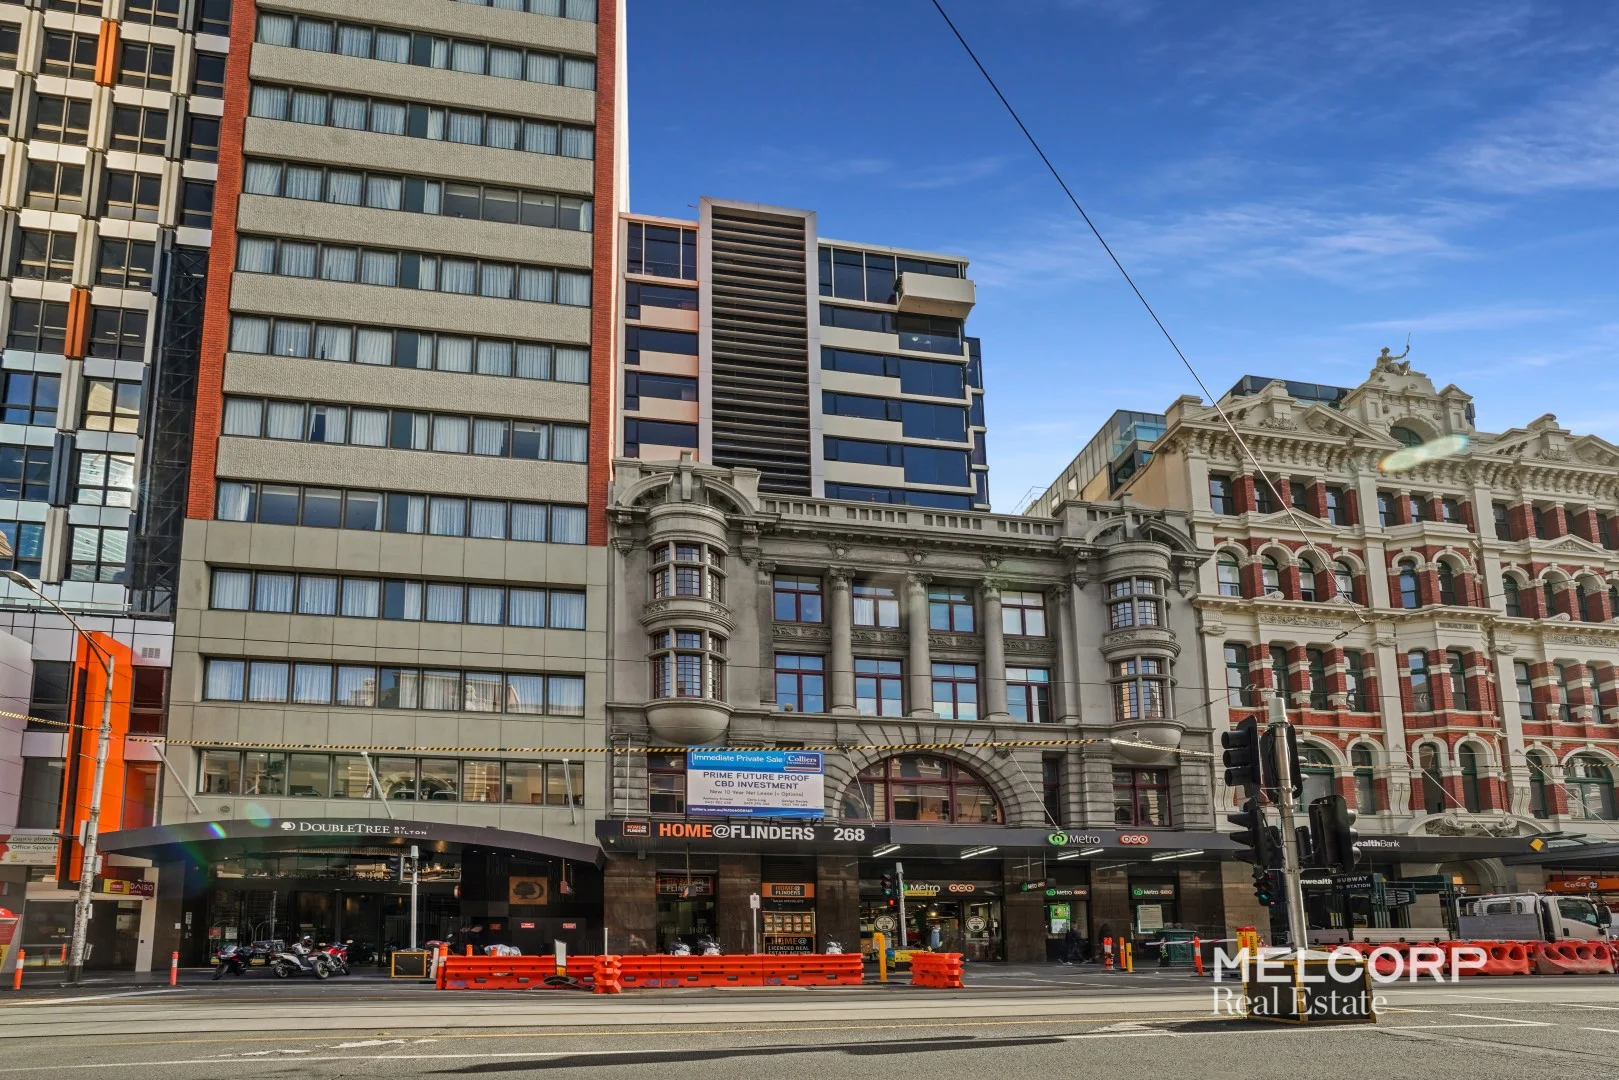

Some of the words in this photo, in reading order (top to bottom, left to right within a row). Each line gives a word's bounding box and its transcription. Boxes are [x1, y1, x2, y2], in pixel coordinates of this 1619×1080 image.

[736, 772, 774, 780] FUTURE
[738, 782, 798, 790] INVESTMENT
[659, 823, 815, 840] HOME@FLINDERS
[834, 828, 865, 842] 268
[1069, 834, 1100, 844] Metro
[910, 884, 940, 892] Metro
